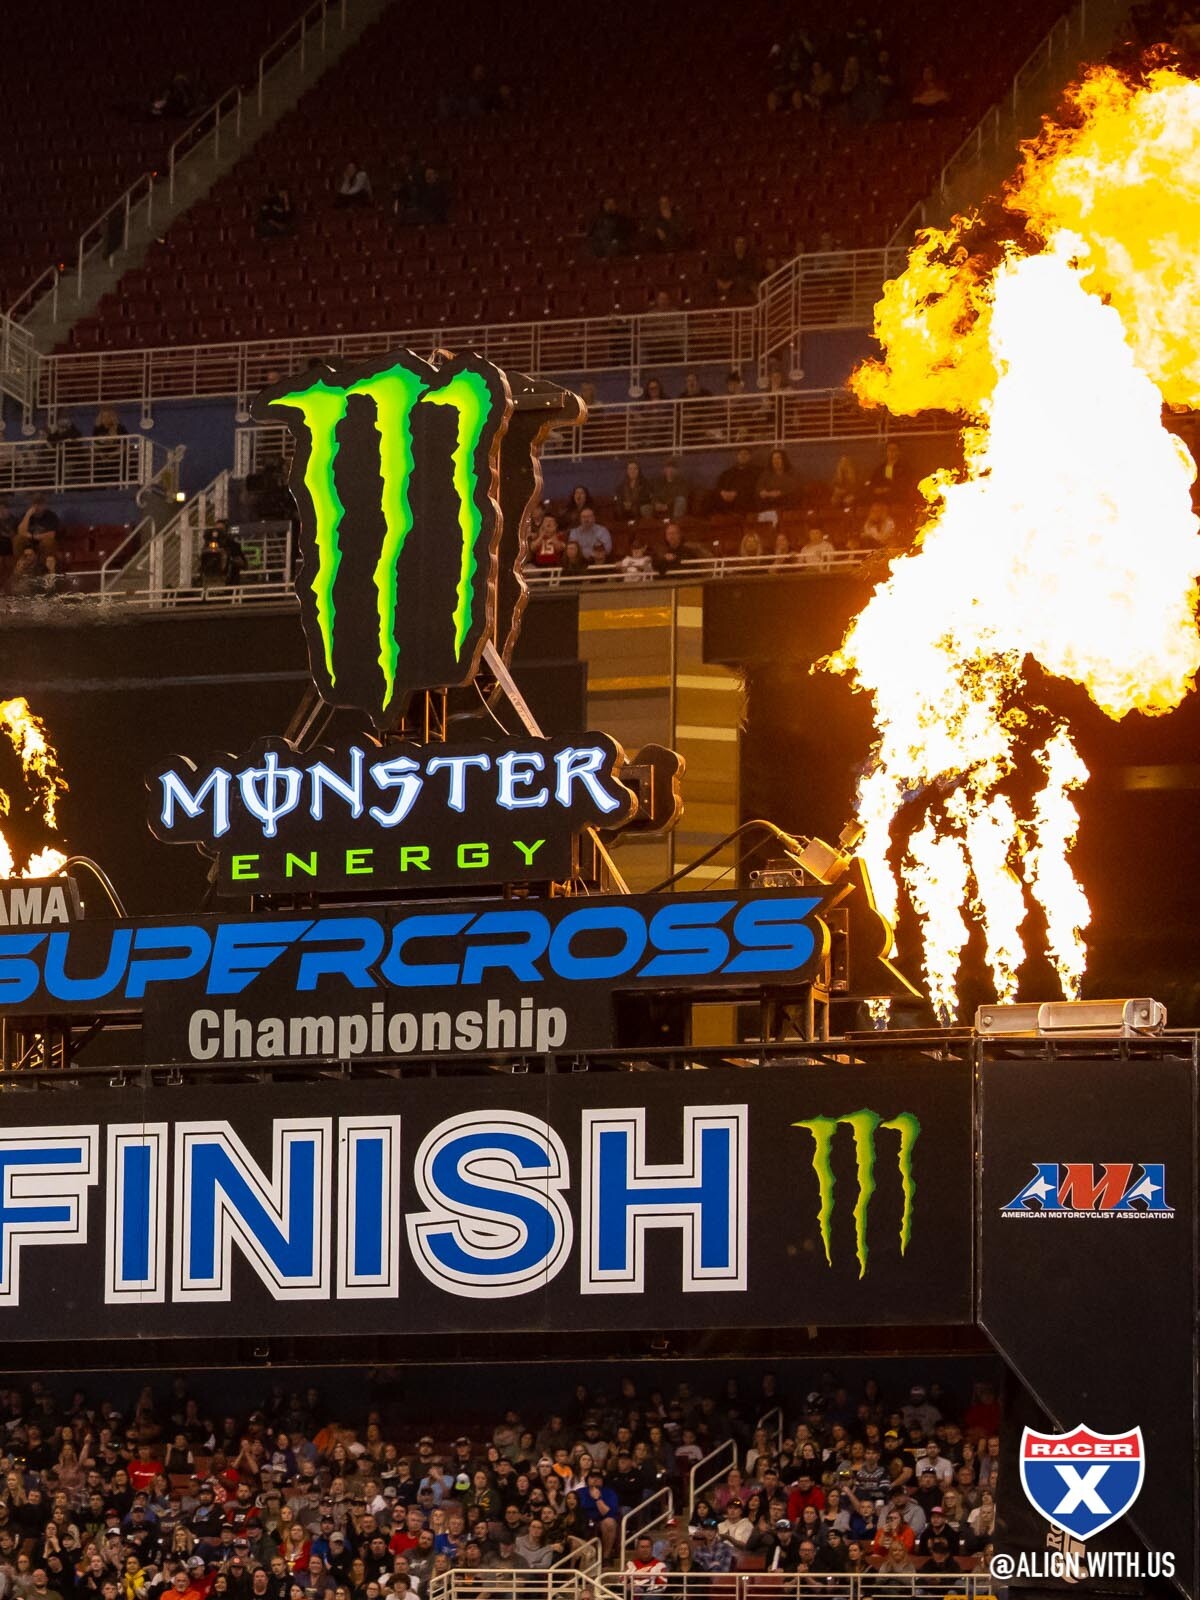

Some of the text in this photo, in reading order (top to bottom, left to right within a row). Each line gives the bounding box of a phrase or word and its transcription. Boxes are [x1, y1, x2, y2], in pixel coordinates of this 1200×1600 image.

[159, 745, 621, 838] MONSTER
[231, 839, 546, 881] ENERGY
[188, 997, 567, 1059] Championship
[999, 1163, 1176, 1210] AMA
[1001, 1211, 1175, 1219] AMERICAN MOTORCYCLIST ASSOCIATION
